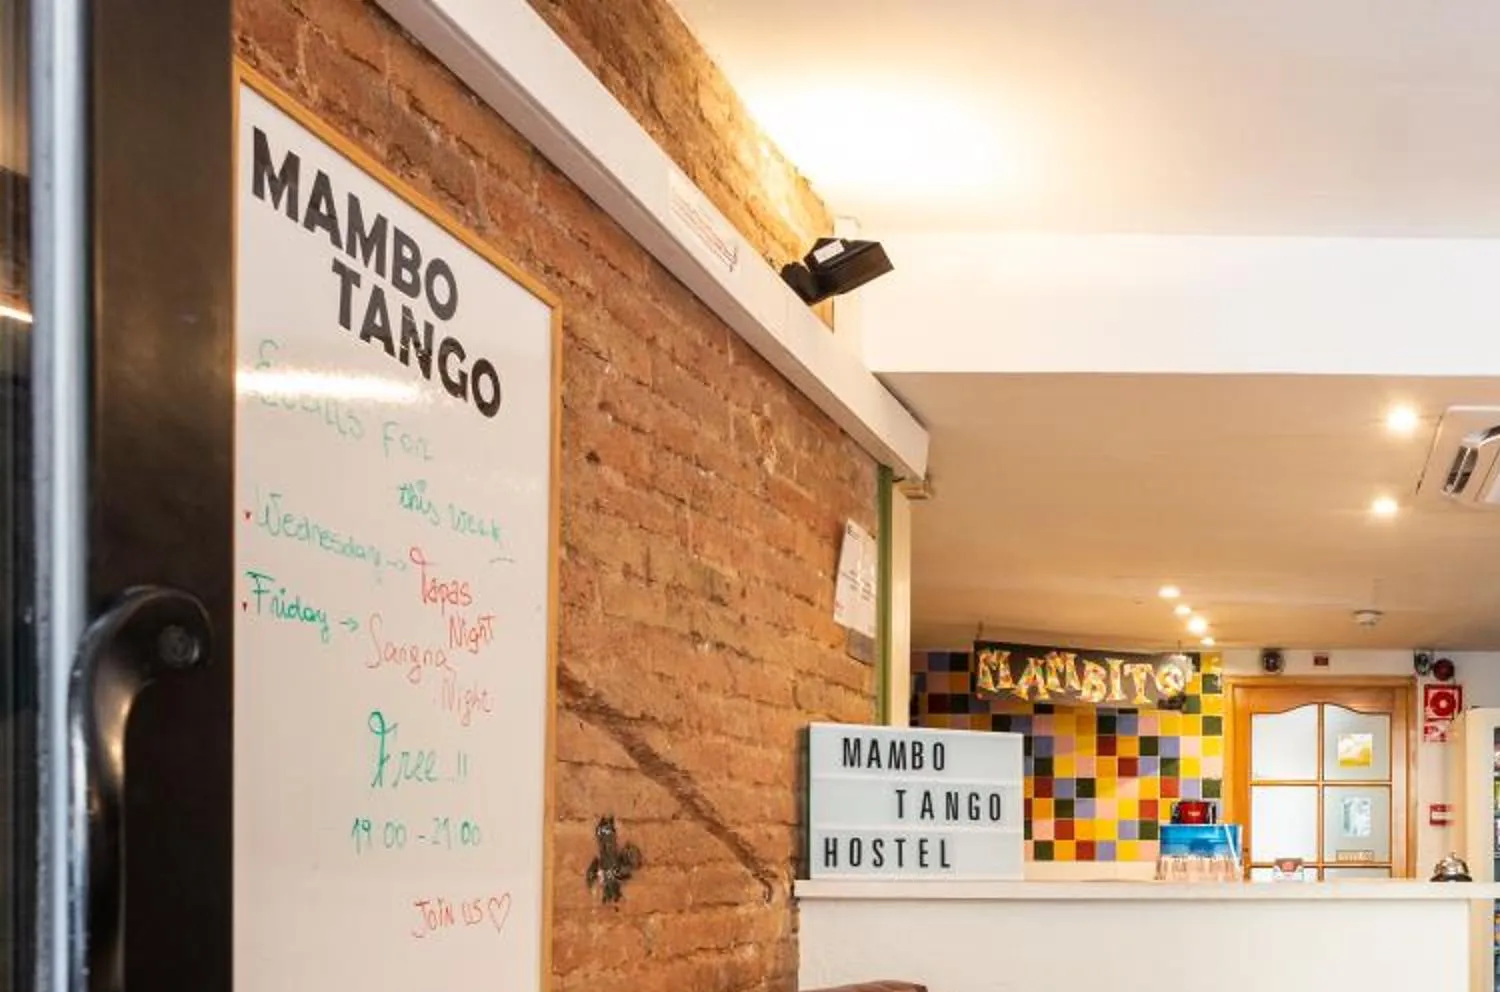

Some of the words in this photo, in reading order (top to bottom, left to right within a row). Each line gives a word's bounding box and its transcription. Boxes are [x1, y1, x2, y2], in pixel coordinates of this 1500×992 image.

[252, 125, 459, 321] MAMBO
[331, 257, 501, 418] TANGO
[244, 570, 330, 644] Friday
[408, 545, 473, 617] Tapas
[976, 649, 1185, 704] MAMBITO
[842, 737, 946, 771] MAMBO
[895, 789, 1001, 821] TANGO
[823, 837, 952, 869] HOSTEL
